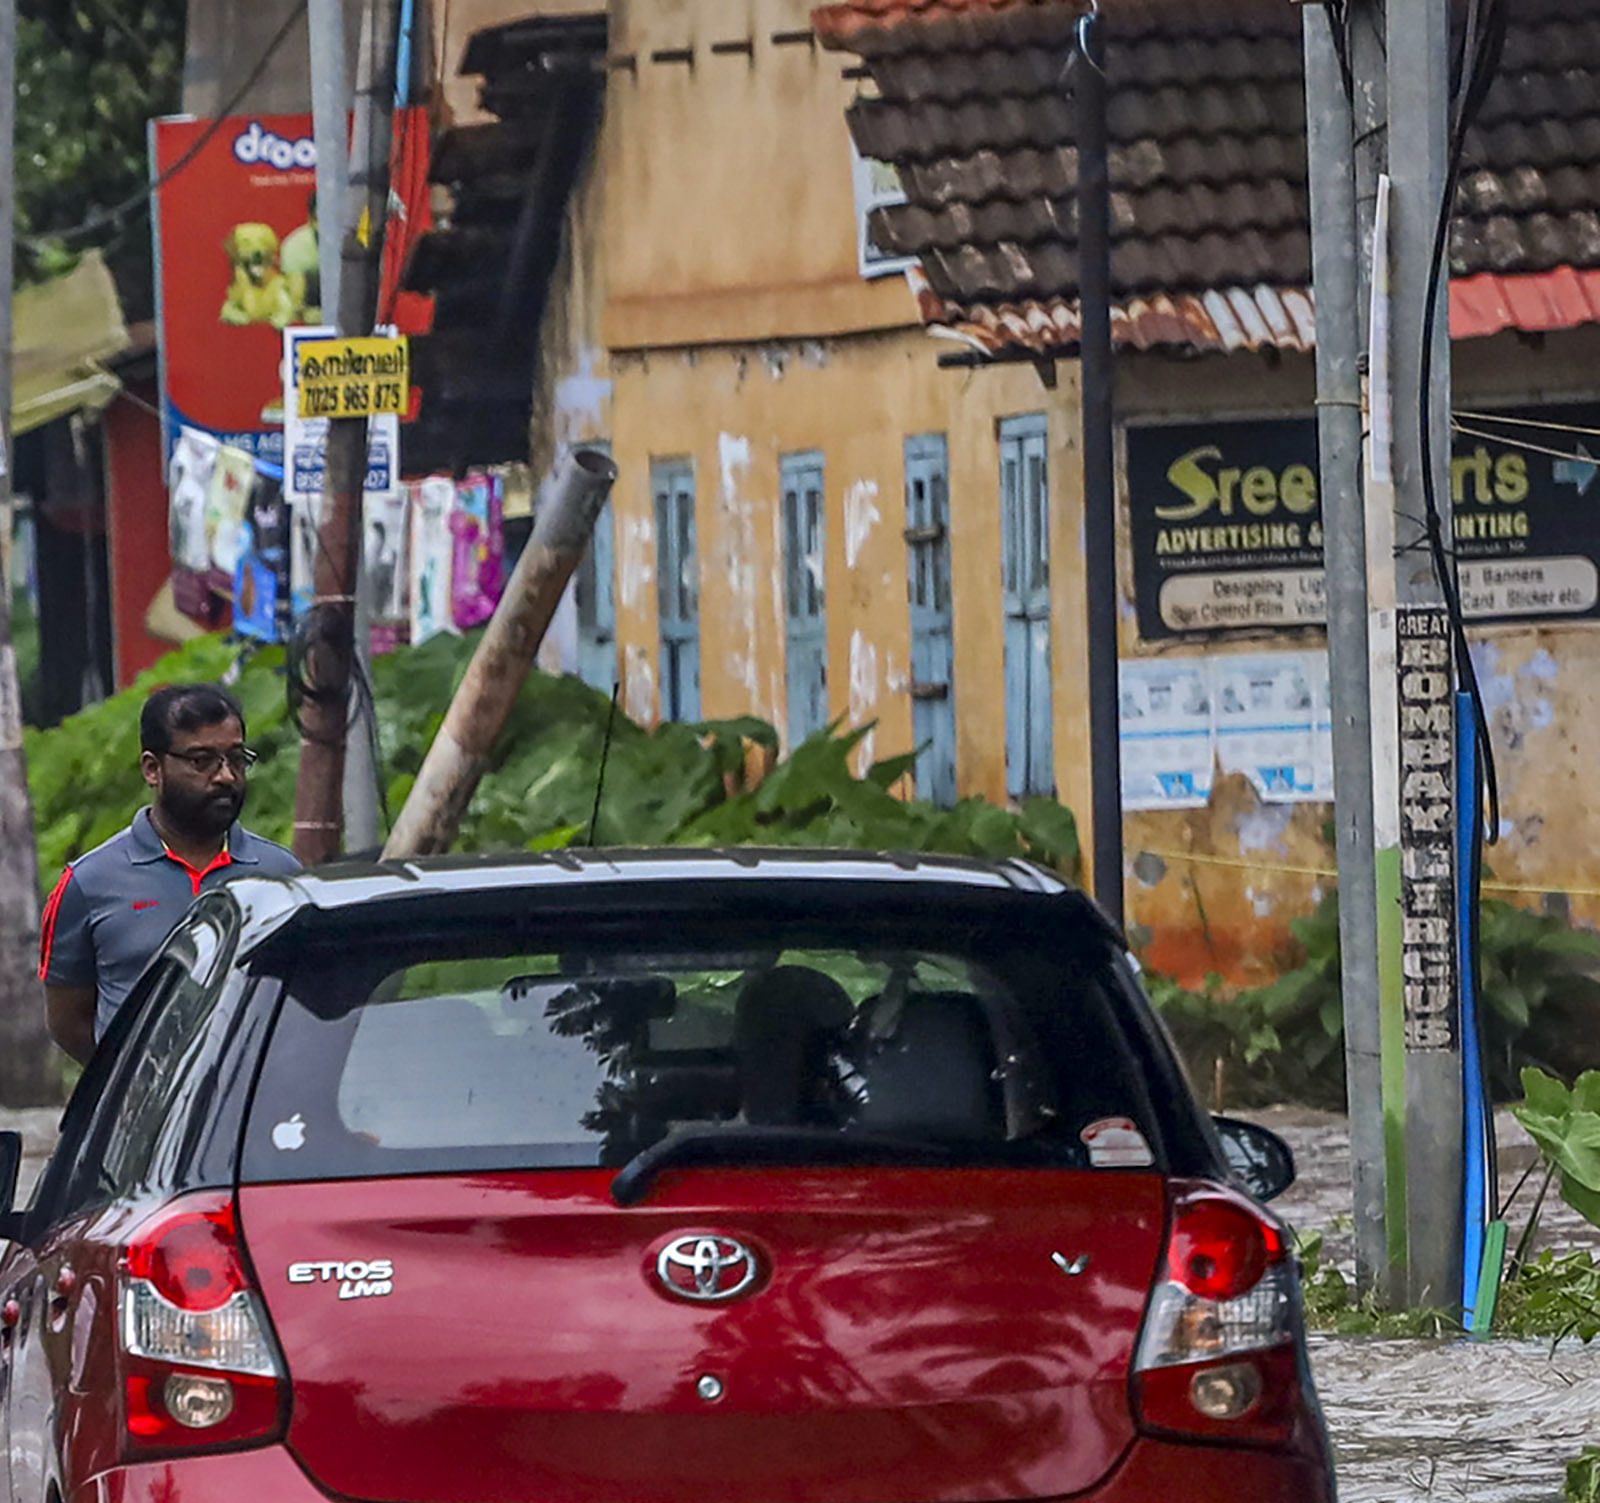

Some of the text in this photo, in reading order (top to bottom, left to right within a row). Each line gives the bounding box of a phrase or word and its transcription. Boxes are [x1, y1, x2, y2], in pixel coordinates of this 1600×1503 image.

[235, 123, 317, 169] droo
[1155, 445, 1530, 520] Sree rts
[1156, 512, 1530, 554] ADVERTISING & INTING
[1398, 614, 1449, 636] GREAT
[1400, 639, 1452, 832] BOMBAY
[288, 1259, 394, 1282] ETIOS
